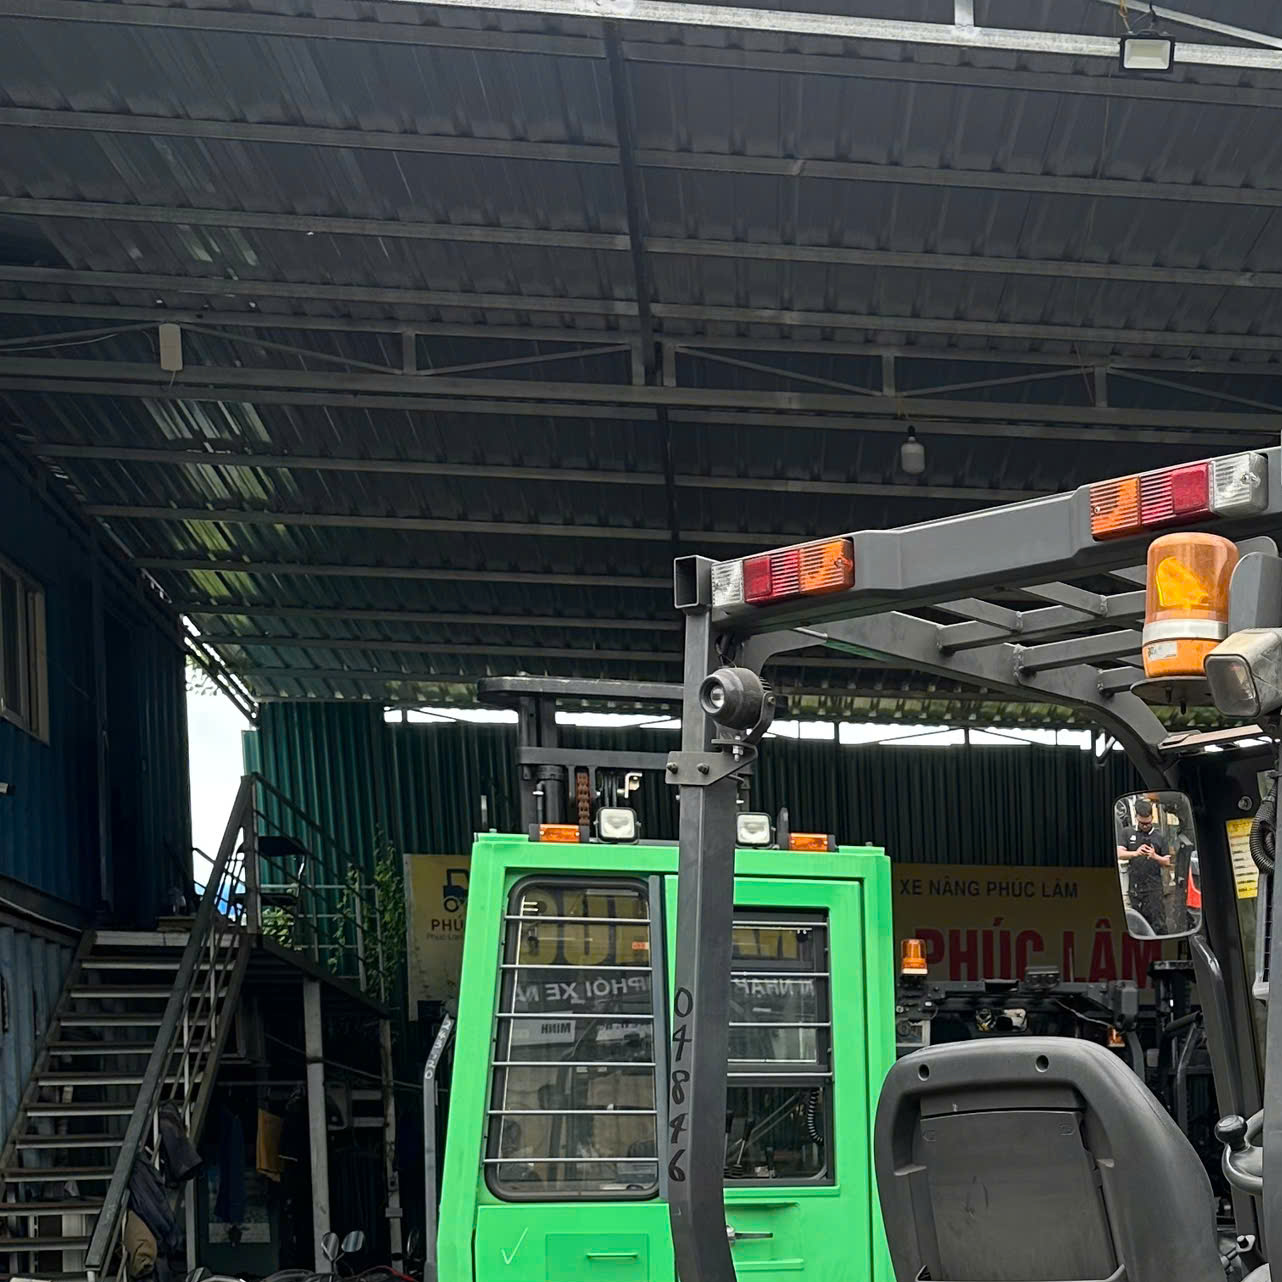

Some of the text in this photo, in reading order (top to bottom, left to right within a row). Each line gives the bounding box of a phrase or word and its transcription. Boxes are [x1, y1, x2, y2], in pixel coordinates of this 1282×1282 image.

[900, 879, 922, 895] XE
[915, 916, 1162, 989] PHÚC LÂM
